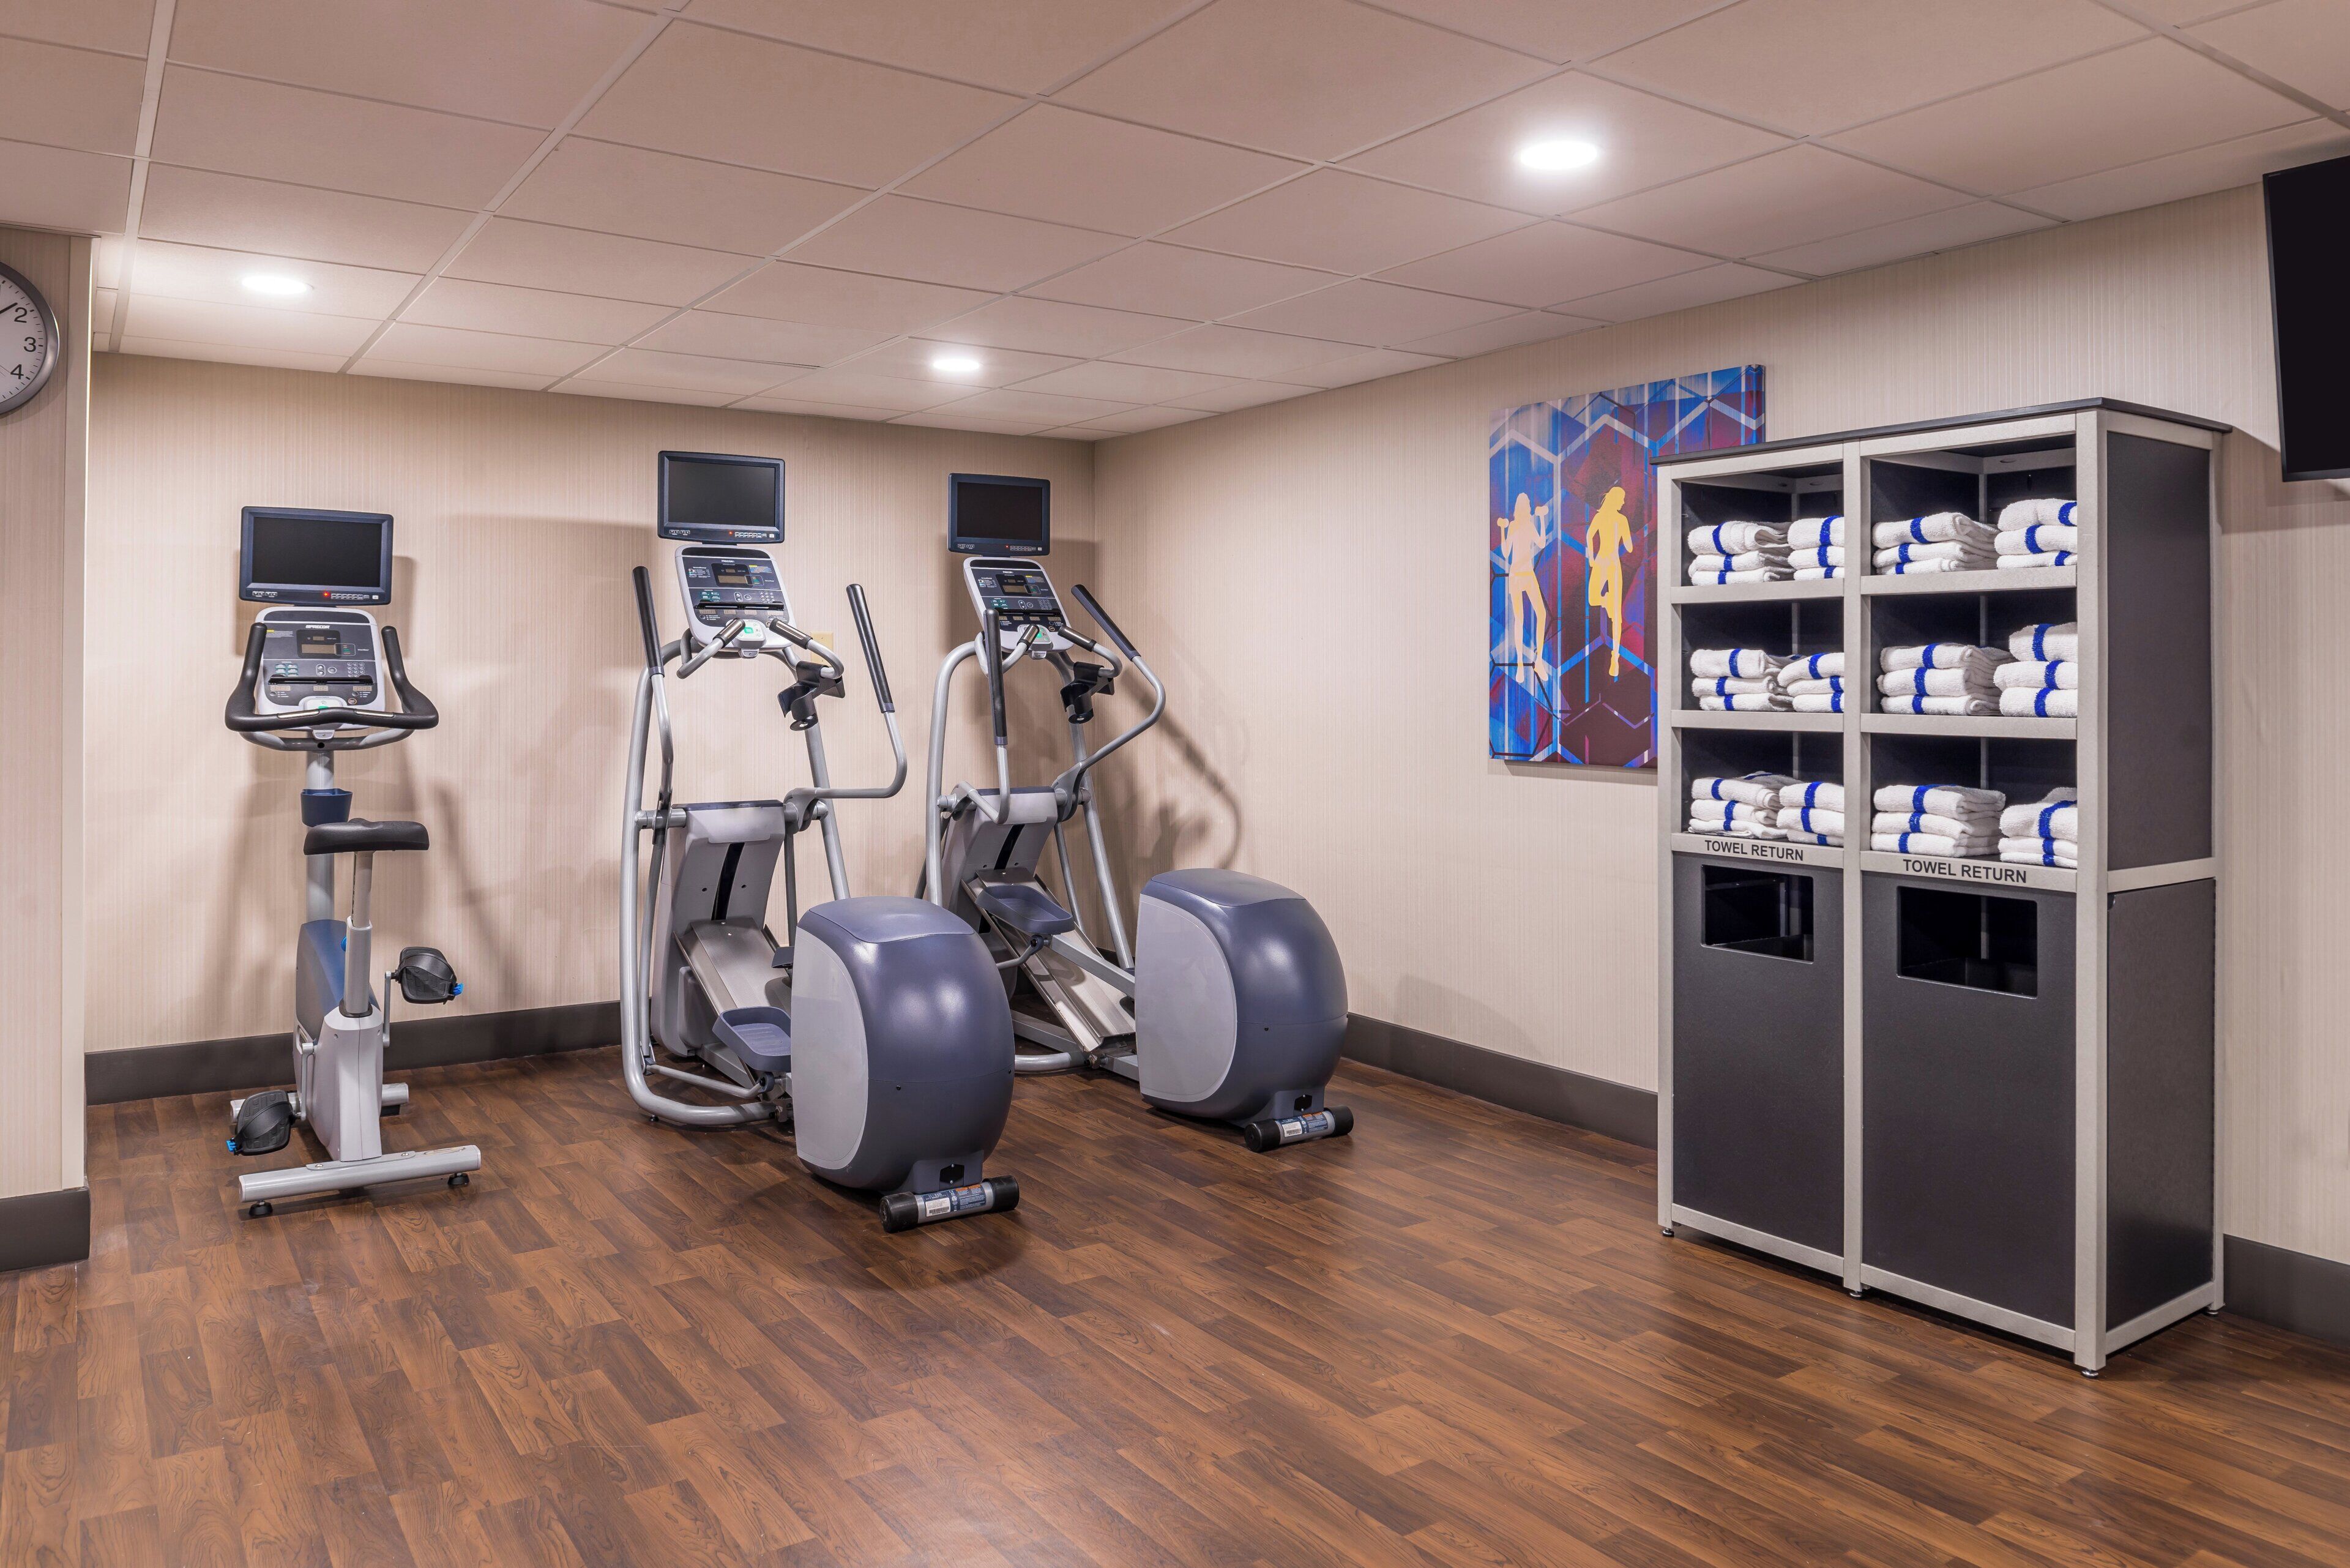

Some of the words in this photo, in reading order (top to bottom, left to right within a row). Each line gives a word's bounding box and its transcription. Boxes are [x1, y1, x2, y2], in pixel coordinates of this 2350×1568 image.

[14, 307, 28, 323] 2
[23, 337, 36, 353] 3
[10, 364, 24, 379] 4
[1704, 840, 1748, 855] TOWEL
[1751, 844, 1804, 861] RETURN
[1903, 859, 1956, 876] TOWEL
[1961, 864, 2027, 883] RETURN
